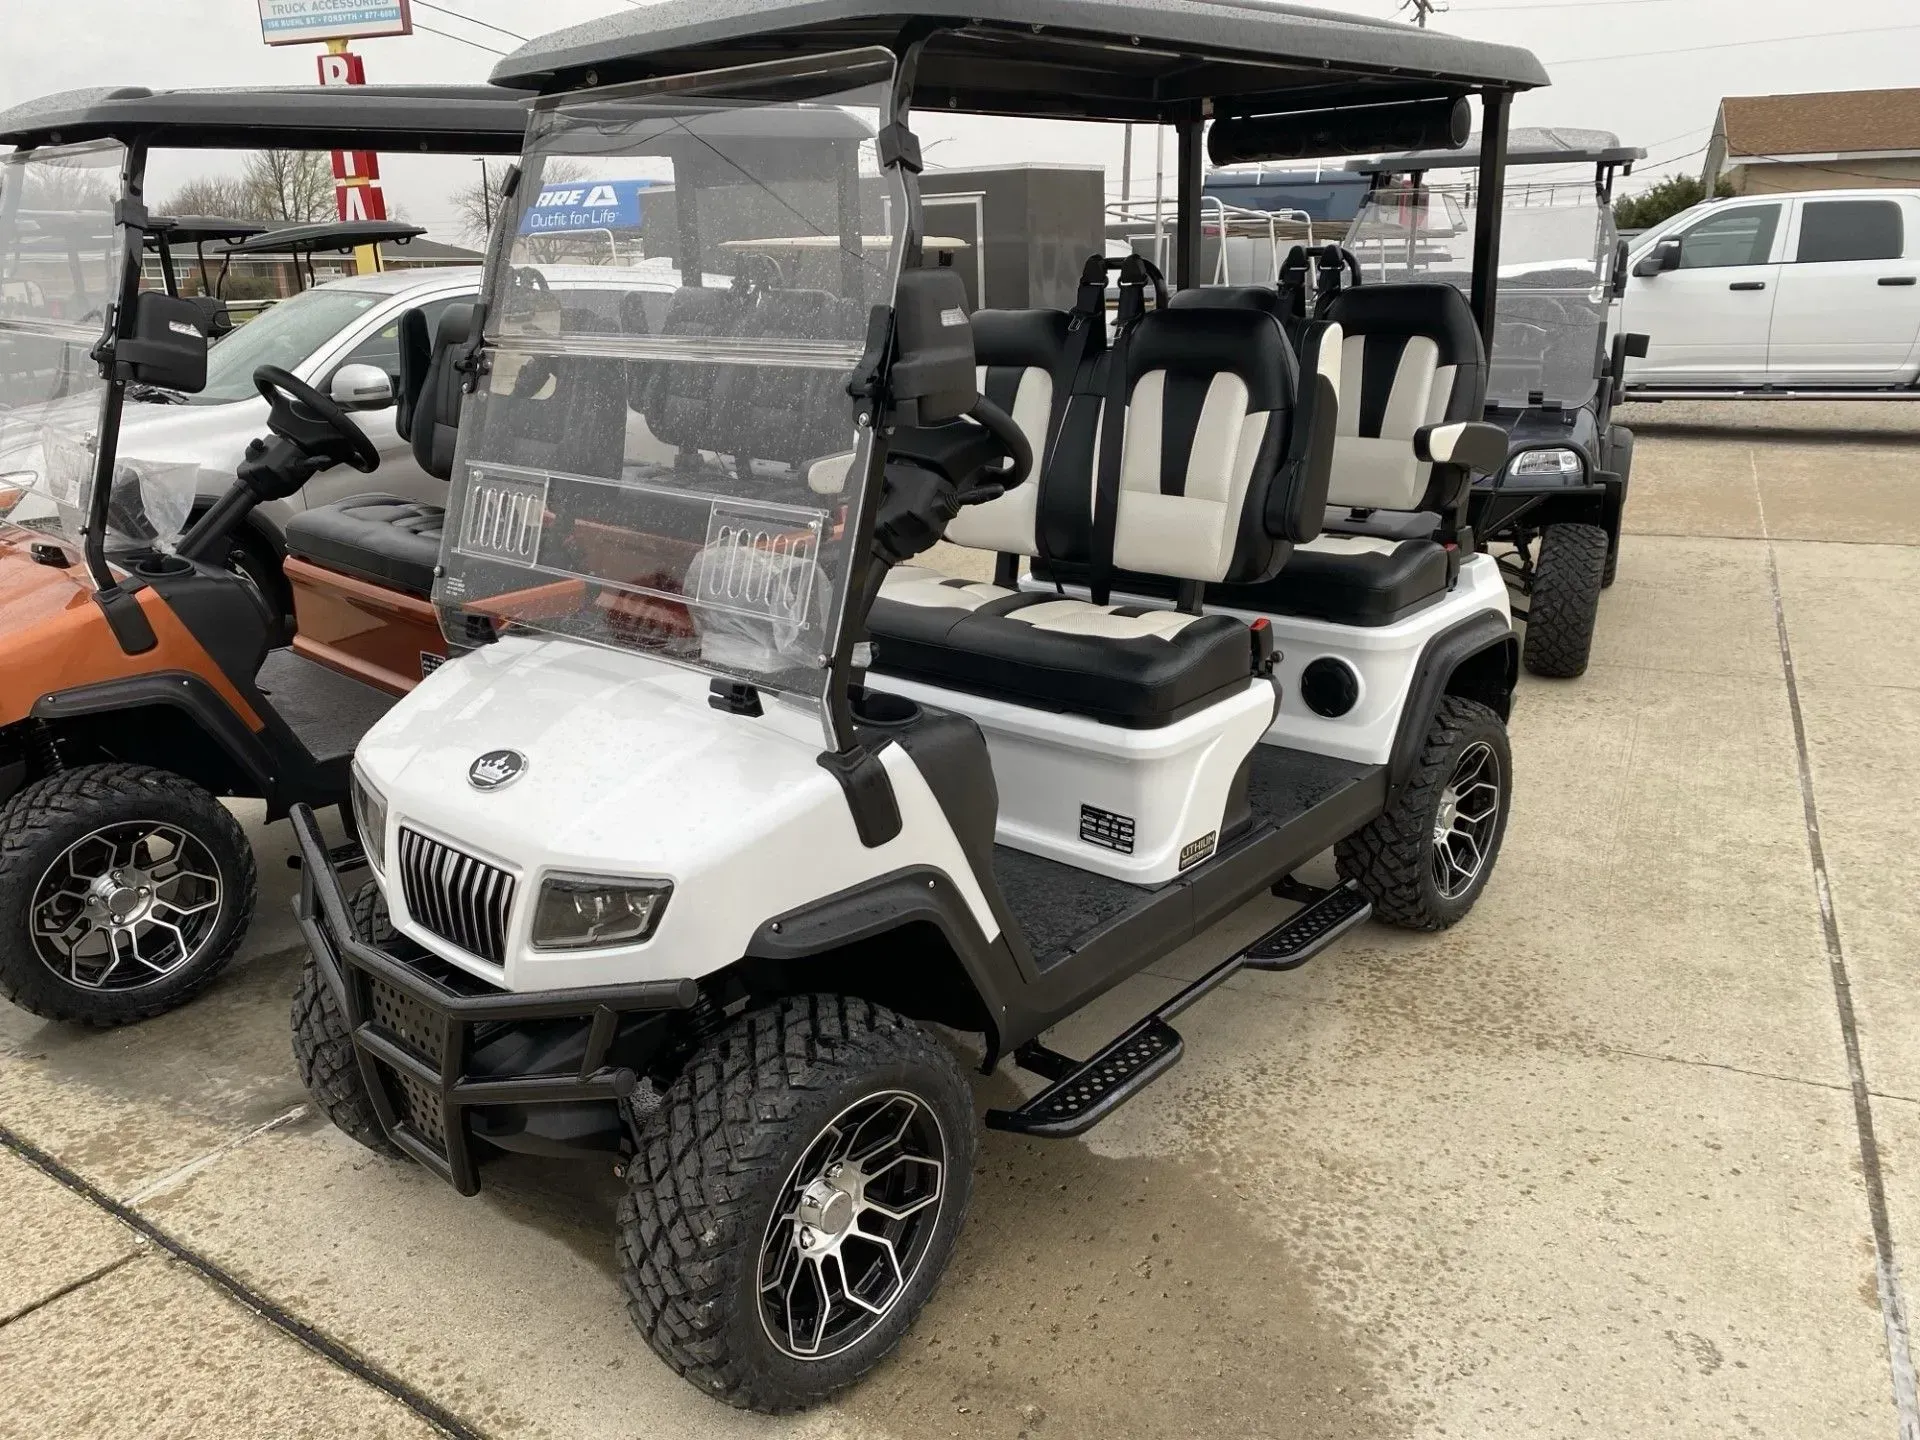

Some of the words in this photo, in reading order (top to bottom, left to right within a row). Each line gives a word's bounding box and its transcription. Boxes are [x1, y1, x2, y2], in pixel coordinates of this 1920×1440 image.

[272, 3, 306, 15] TRUCK
[323, 14, 358, 23] FORSYTH
[530, 211, 567, 228] Outfit
[570, 210, 590, 225] for
[591, 209, 616, 224] Life
